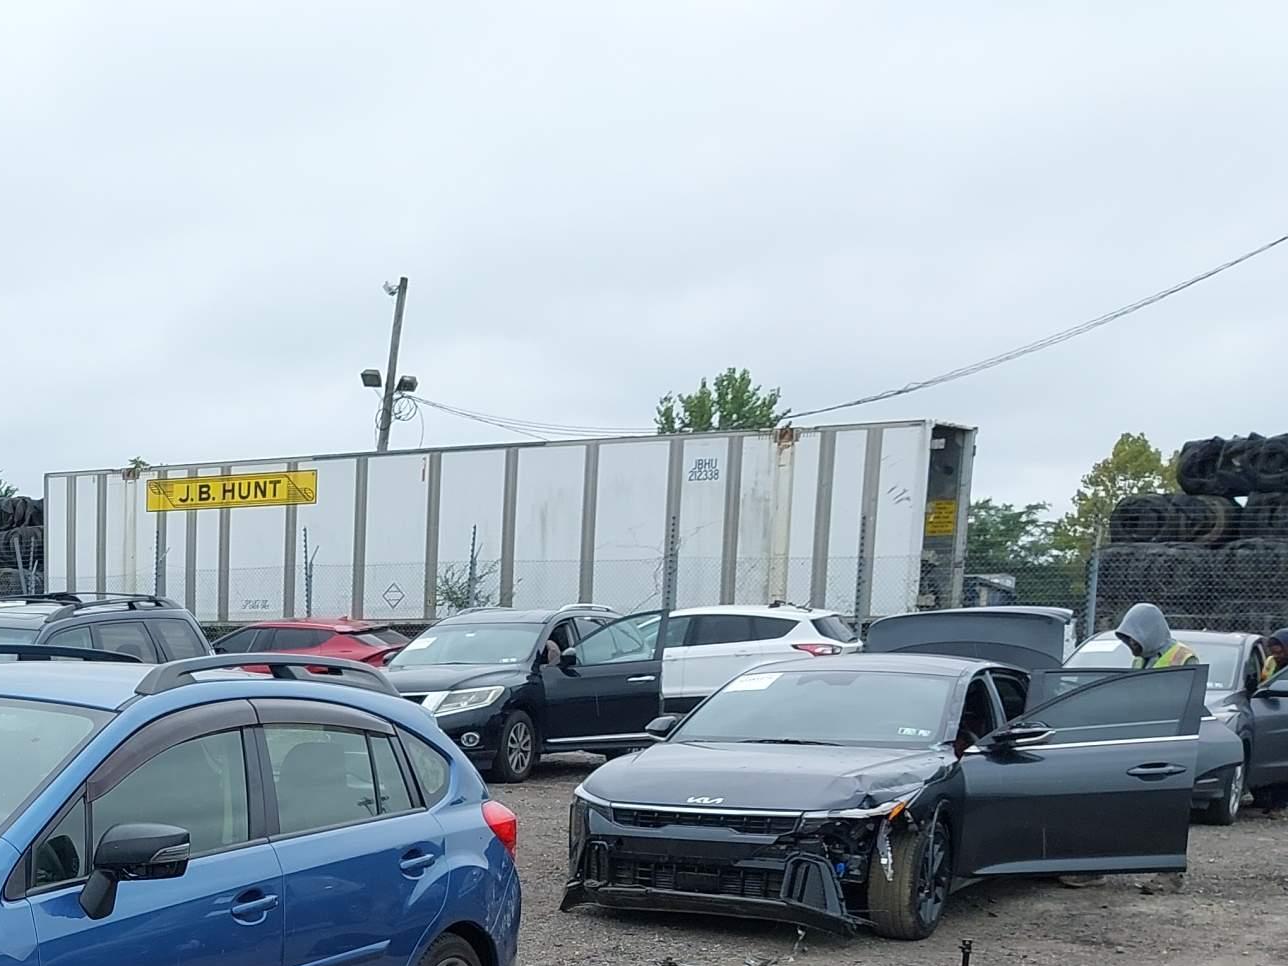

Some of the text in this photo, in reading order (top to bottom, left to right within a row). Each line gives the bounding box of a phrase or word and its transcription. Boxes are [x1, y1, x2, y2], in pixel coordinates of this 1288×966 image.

[692, 458, 718, 470] JBHU
[688, 469, 719, 481] 212338
[178, 480, 282, 503] J.B. HUNT
